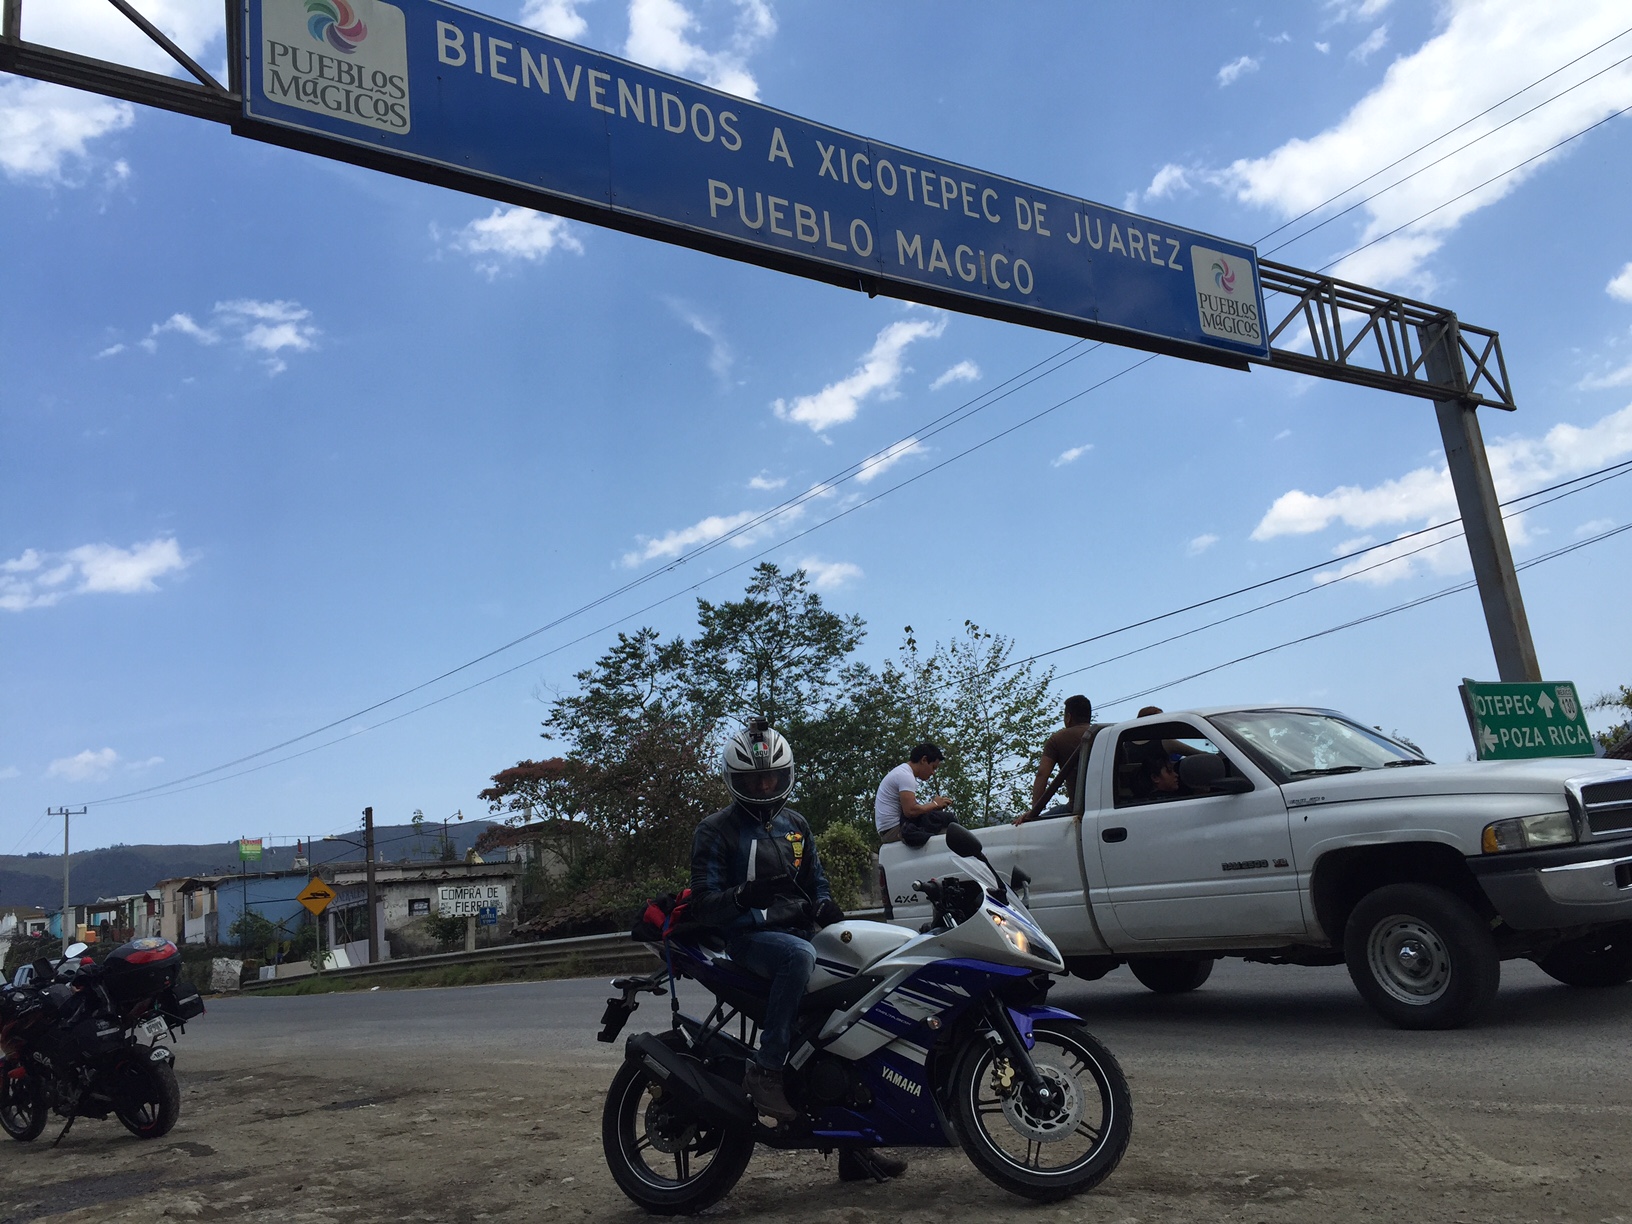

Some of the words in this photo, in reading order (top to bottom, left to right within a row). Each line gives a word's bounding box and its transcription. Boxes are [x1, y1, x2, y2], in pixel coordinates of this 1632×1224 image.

[435, 20, 742, 151] BIENVENIDOS
[768, 127, 794, 168] A
[815, 140, 1001, 223] XICOTEPEC
[1014, 196, 1051, 237] DE
[1066, 212, 1184, 272] JUAREZ
[707, 179, 874, 257] PUEBLO
[896, 229, 1034, 295] MAGICO
[1500, 726, 1546, 748] POZA
[1548, 724, 1589, 746] RICA
[441, 888, 482, 900] COMPRA
[487, 887, 499, 898] DE
[881, 1065, 922, 1097] YAMAHA
